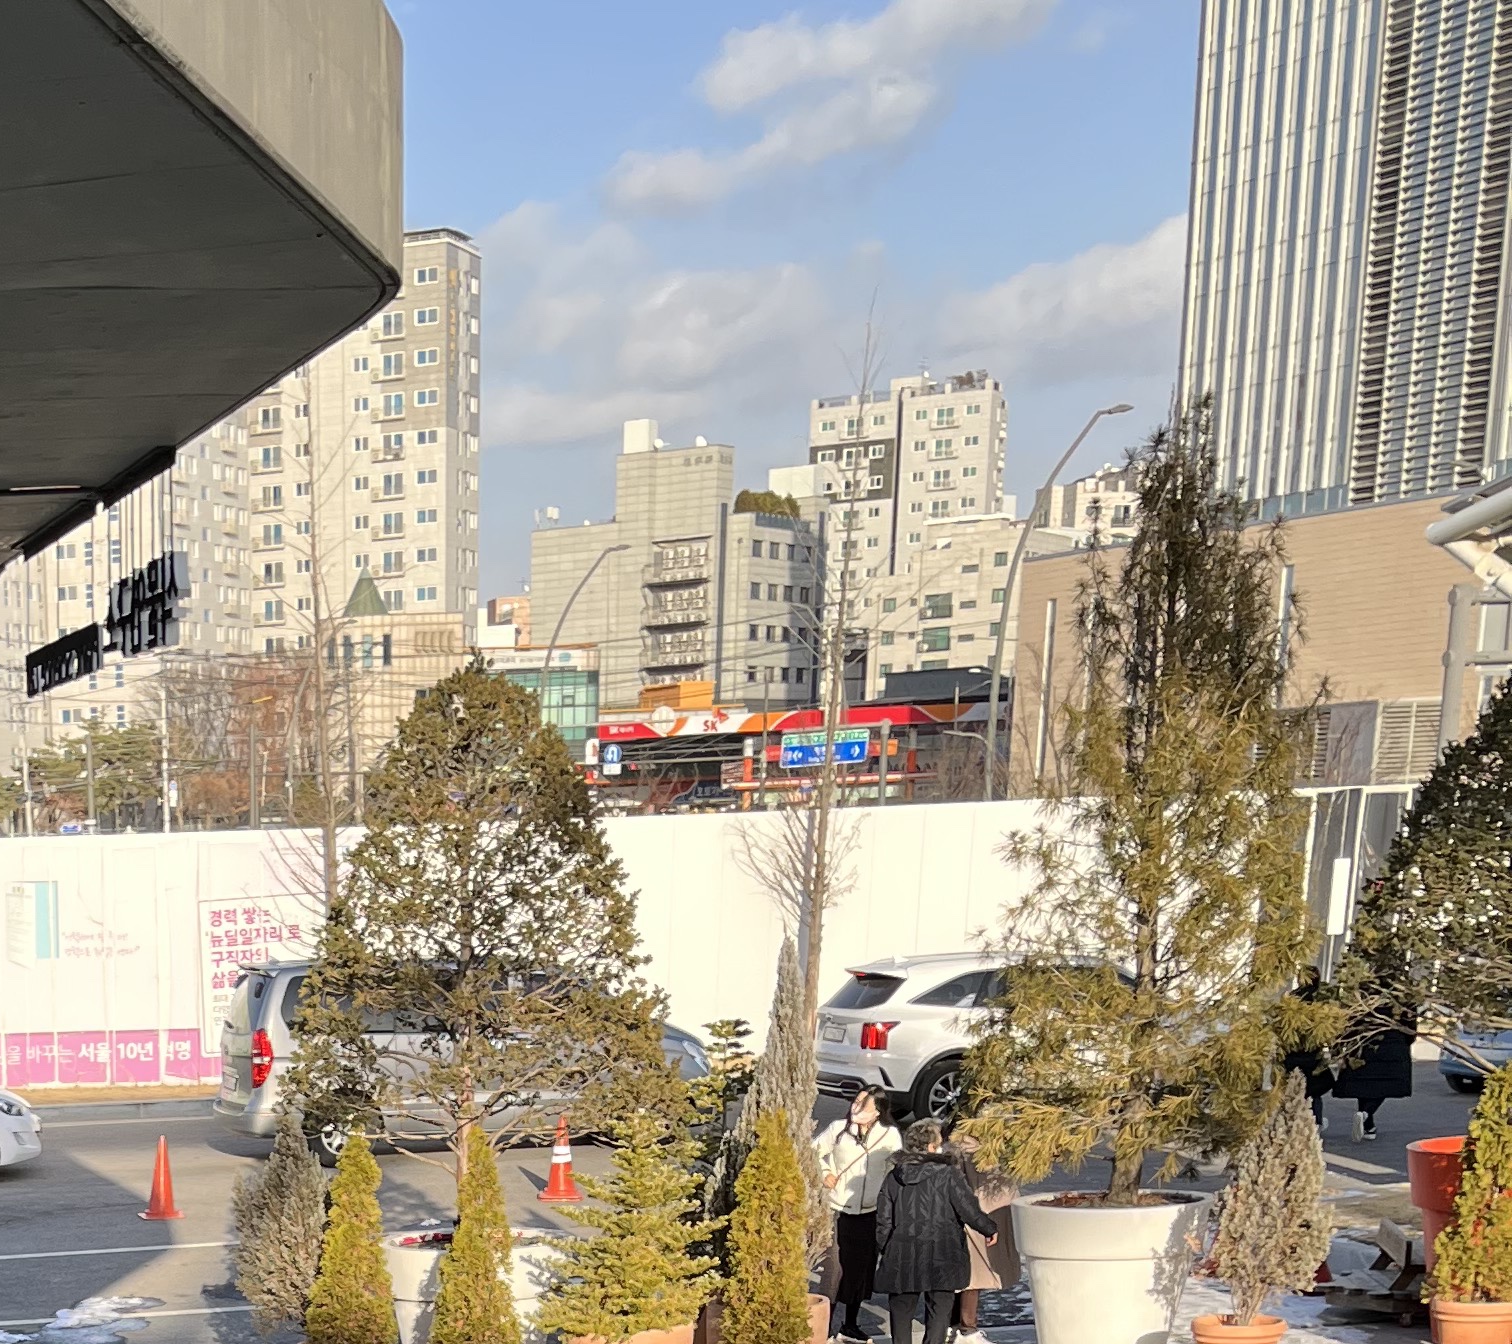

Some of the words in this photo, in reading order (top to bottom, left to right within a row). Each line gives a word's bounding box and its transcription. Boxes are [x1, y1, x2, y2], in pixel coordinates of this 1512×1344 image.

[703, 719, 718, 732] SK
[210, 908, 238, 927] 경력
[210, 946, 269, 968] 구직자의
[25, 1044, 74, 1064] 바꾸는
[77, 1042, 112, 1063] 서울
[116, 1041, 153, 1061] 10년
